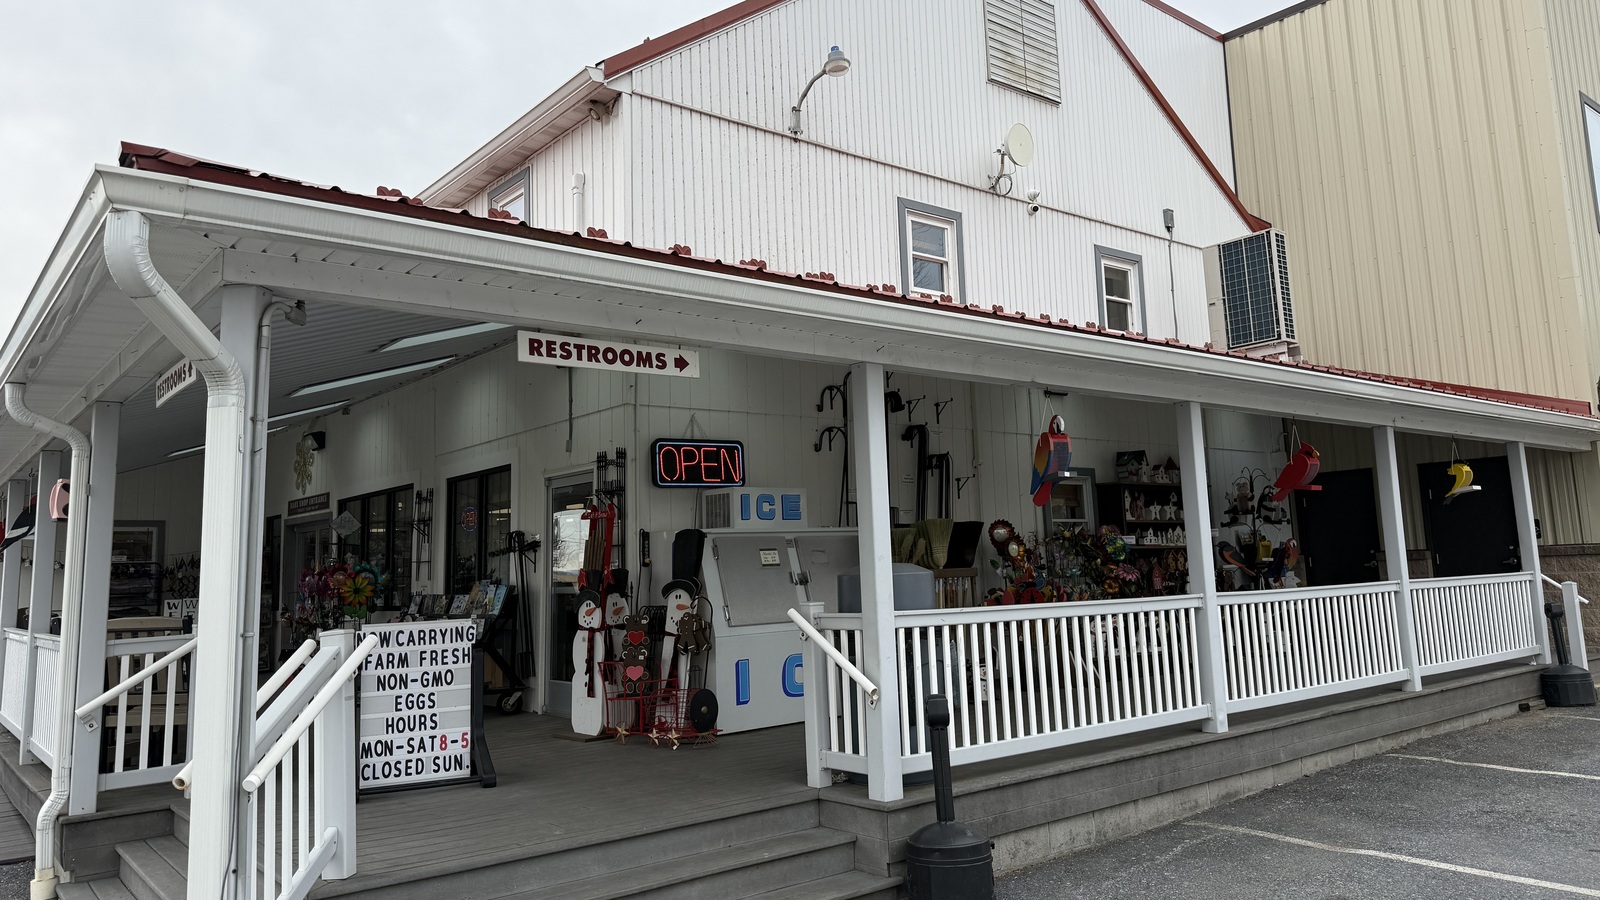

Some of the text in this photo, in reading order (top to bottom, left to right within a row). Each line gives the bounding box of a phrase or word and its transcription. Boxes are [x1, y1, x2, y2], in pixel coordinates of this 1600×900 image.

[528, 337, 667, 370] RESTROOMS
[157, 363, 187, 401] RESTROOMS
[659, 446, 741, 482] OPEN
[740, 493, 802, 521] ICE
[395, 625, 475, 646] CARRYING
[364, 647, 471, 670] FARM FRESH
[376, 669, 454, 691] NON-GMO
[735, 653, 805, 706] IC
[394, 692, 436, 712] EGGS
[385, 713, 438, 734] HOURS
[361, 753, 470, 781] CLOSED SUN.
